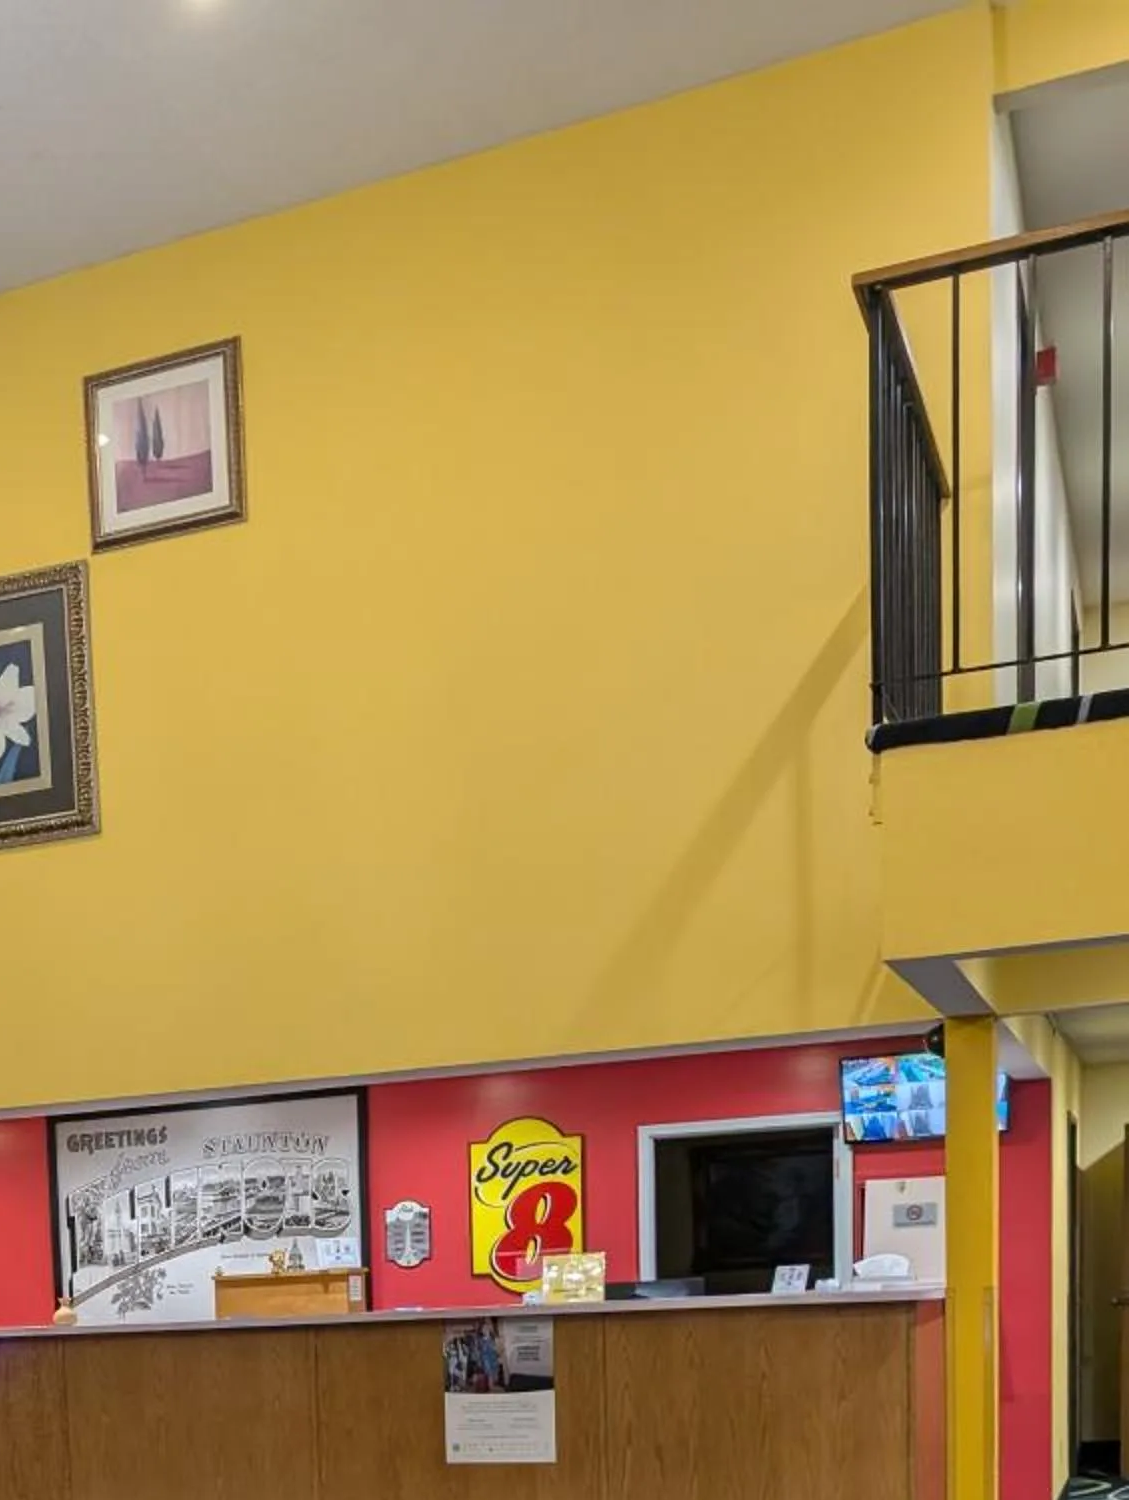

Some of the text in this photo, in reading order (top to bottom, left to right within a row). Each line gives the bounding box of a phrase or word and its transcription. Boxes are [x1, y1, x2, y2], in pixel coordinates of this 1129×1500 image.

[66, 1125, 169, 1155] GREETINGS
[202, 1131, 331, 1160] STAUNTON
[475, 1141, 578, 1201] Super
[489, 1181, 578, 1282] 8
